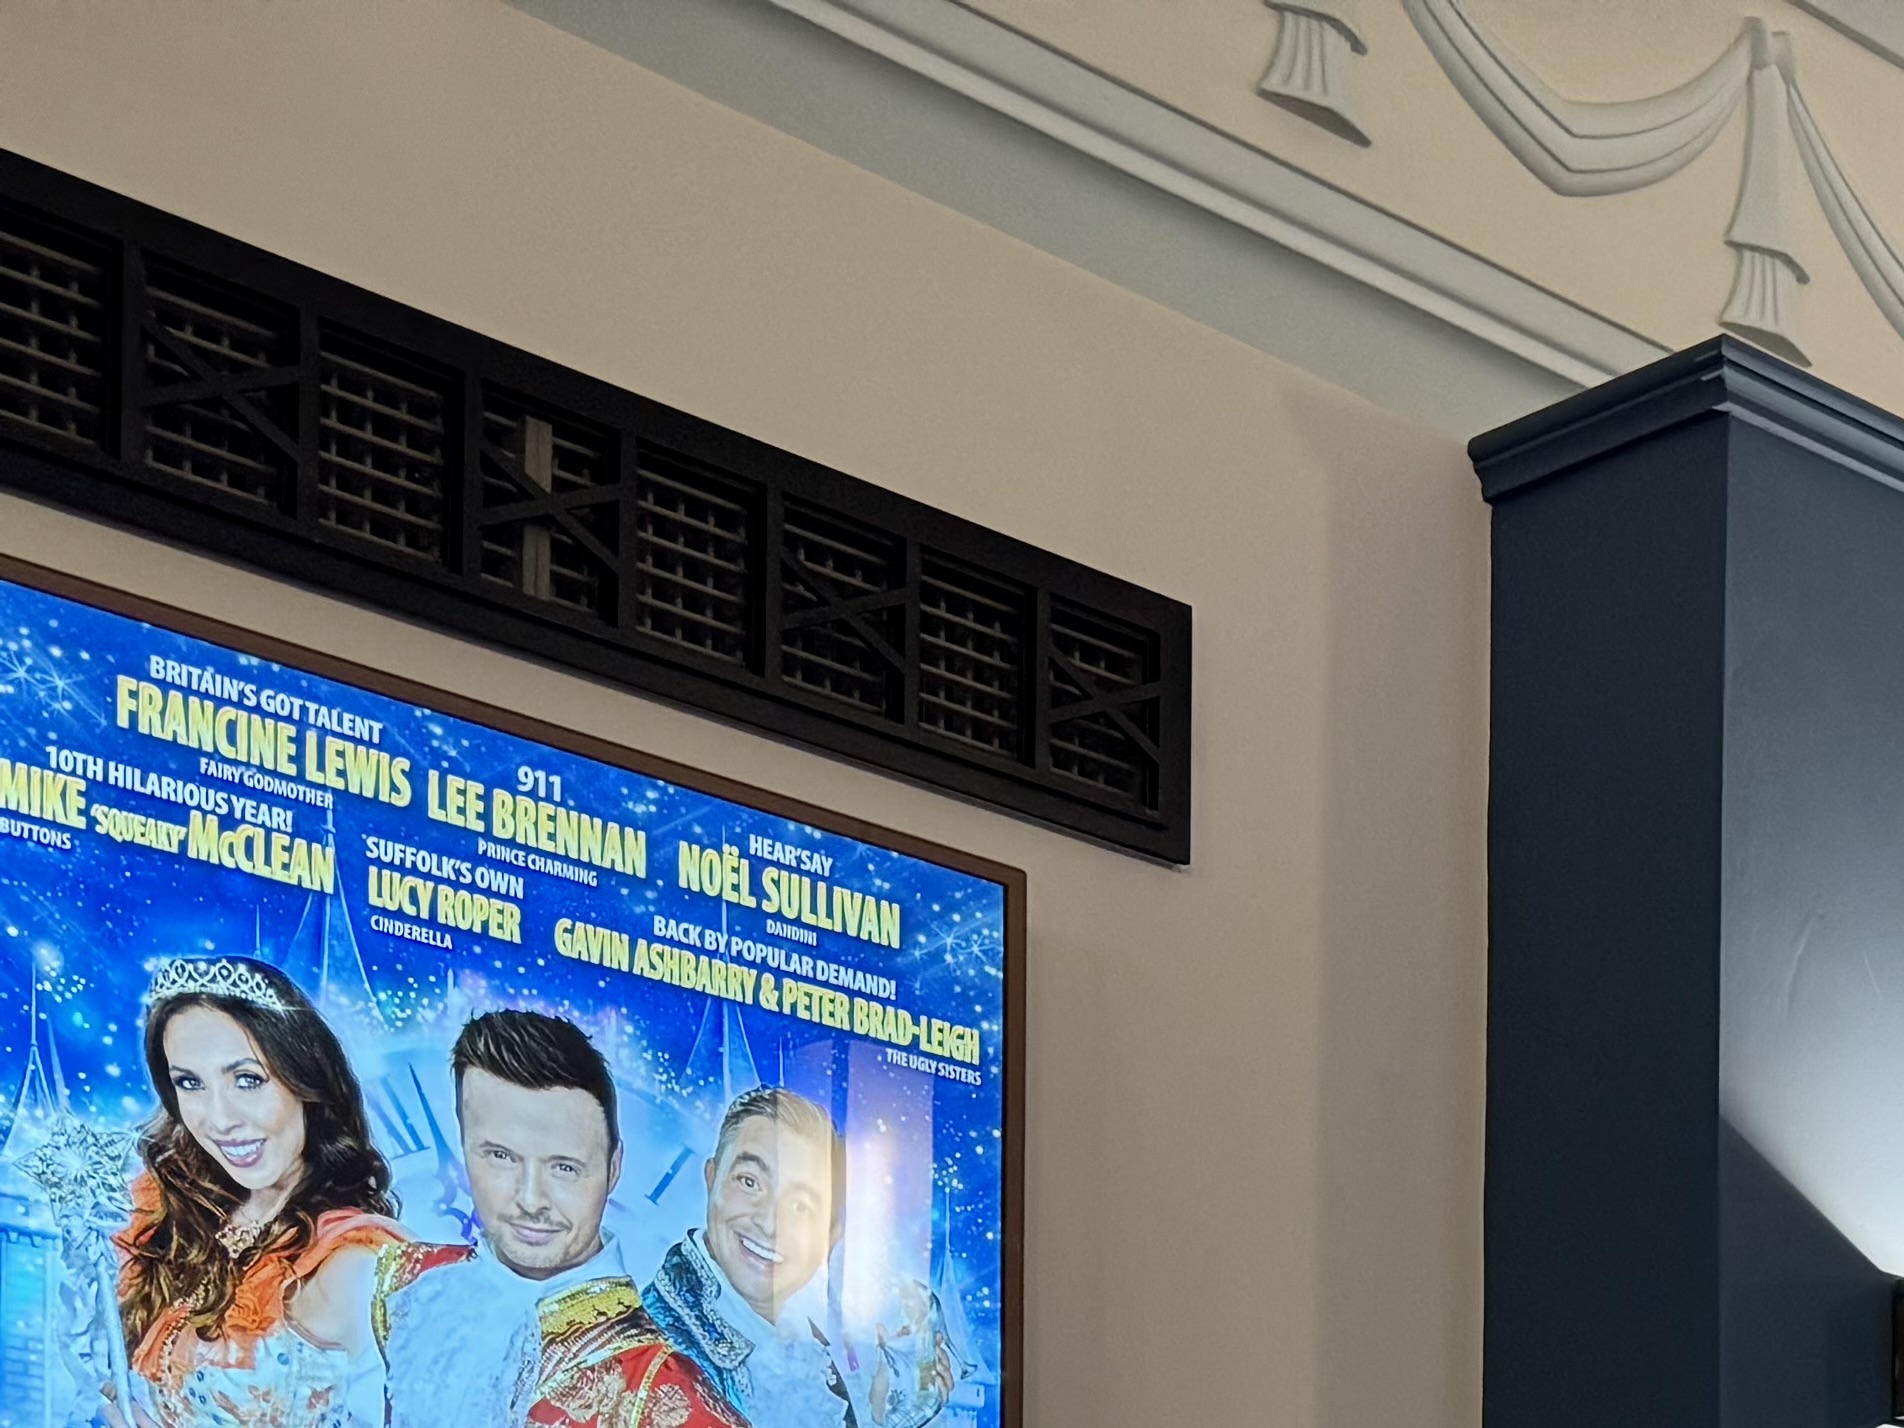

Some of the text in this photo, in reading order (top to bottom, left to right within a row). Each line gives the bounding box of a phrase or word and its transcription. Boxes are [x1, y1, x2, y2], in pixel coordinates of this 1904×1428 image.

[150, 655, 383, 744] BRITAIN'S GOT TALENT
[116, 675, 411, 807] FRANCINE LEWIS
[46, 746, 292, 832] 10TH HILARIOUS YEAR!
[200, 757, 334, 808] FAIRY GODMOTHER
[517, 766, 562, 802] 911
[0, 759, 87, 829] MIKE
[188, 810, 334, 894] McCLEAN
[0, 817, 71, 850] BUTTONS
[428, 769, 646, 879] LEE BRENNAN
[478, 838, 598, 887] PRINCE CHARMING
[366, 837, 524, 899] SUFFOLK'S OWN
[368, 866, 522, 944] LUCY ROPER
[678, 840, 900, 950] NOËL SULLIVAN
[370, 916, 453, 949] CINDERELLA
[653, 915, 897, 1001] BACK BY POPULAR DEMAND!
[766, 918, 817, 947] DANDINI
[554, 917, 981, 1067] GAVIN ASHBARRY & PETER BRAD-LEIGH
[886, 1048, 982, 1087] THE UGLY SISTERS
